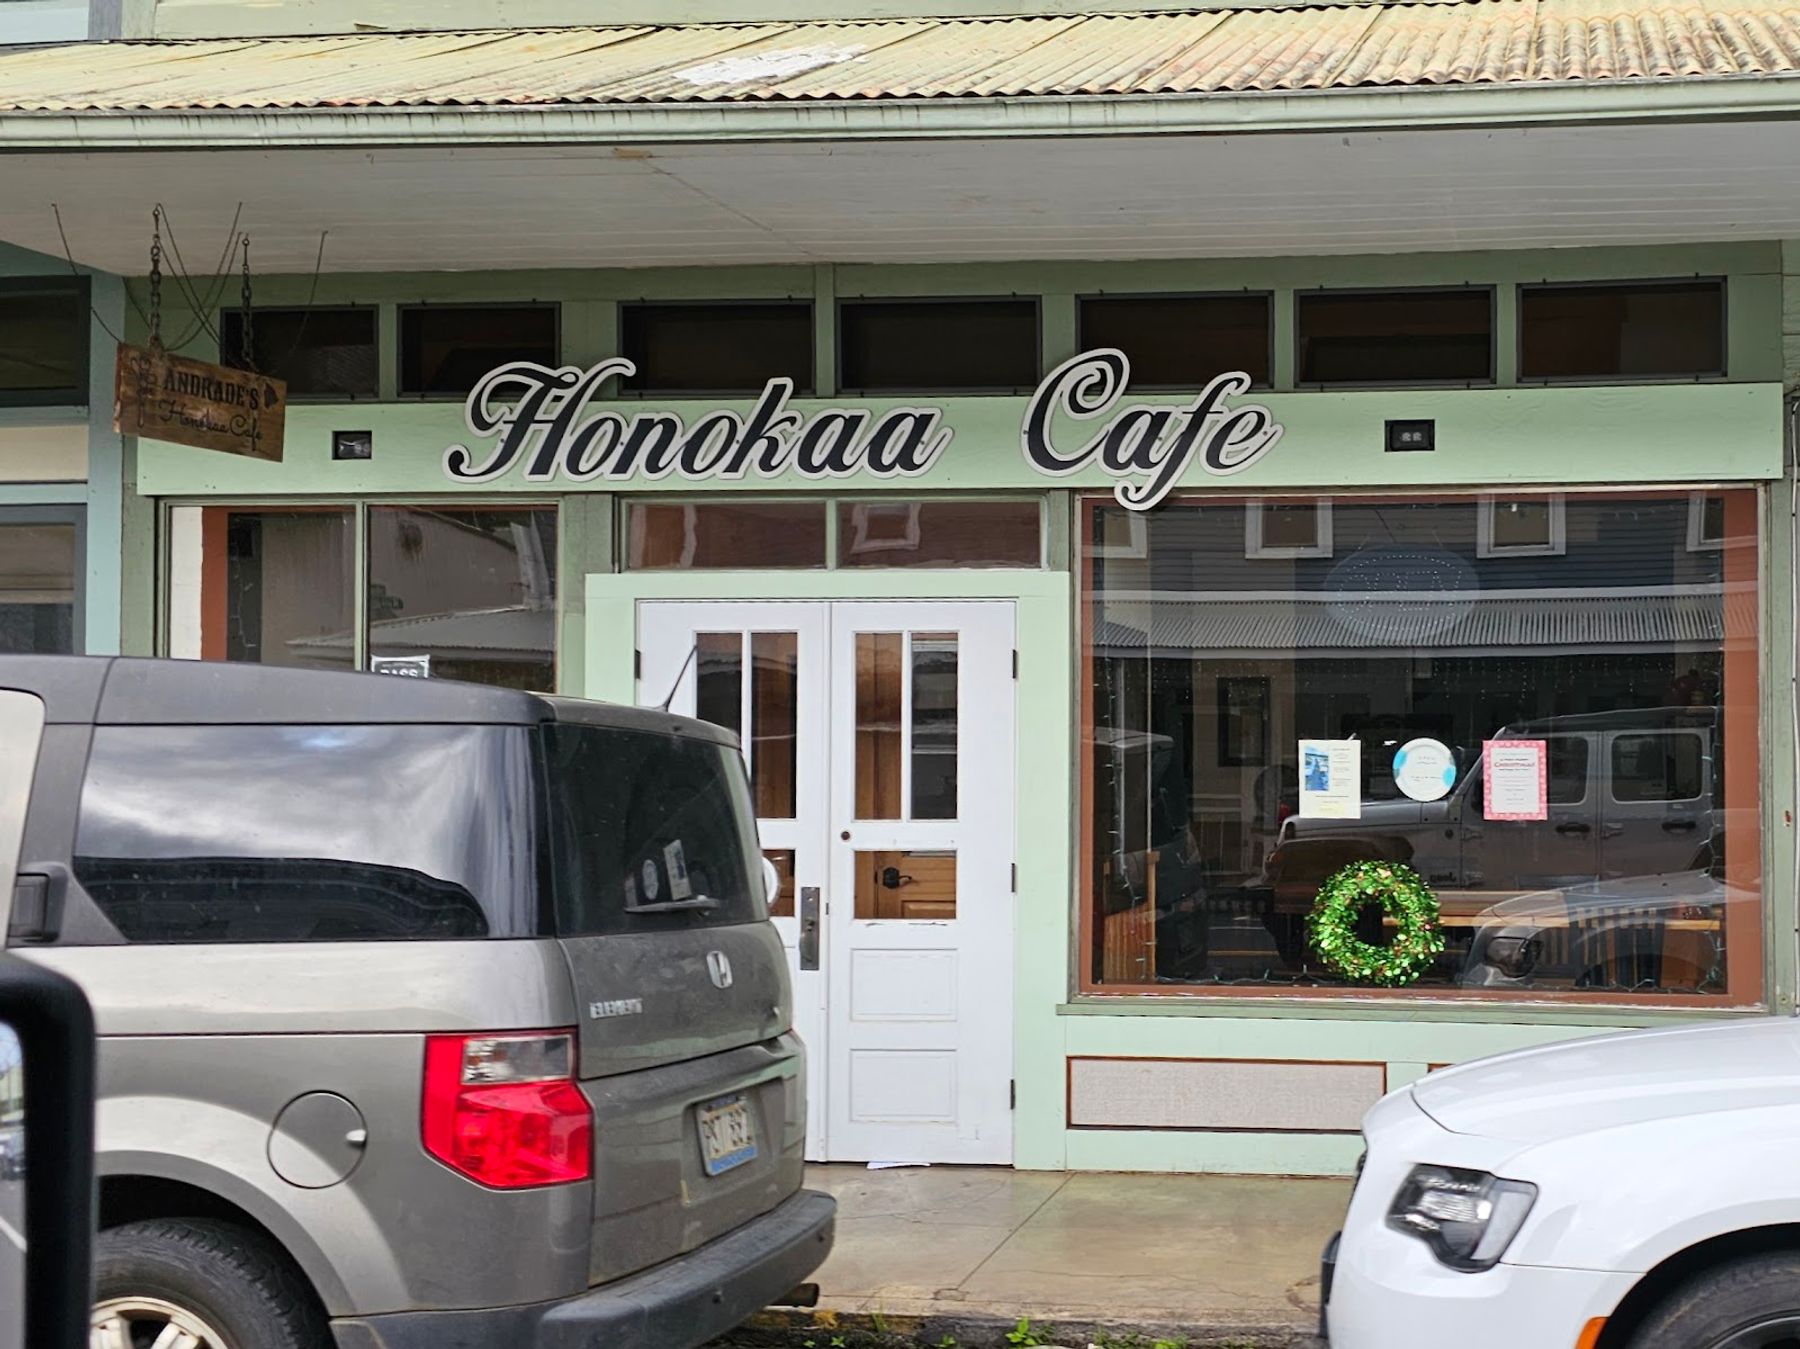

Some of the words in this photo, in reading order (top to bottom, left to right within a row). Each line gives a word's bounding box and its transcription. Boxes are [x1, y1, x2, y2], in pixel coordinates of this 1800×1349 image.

[163, 369, 261, 411] ANDRADE'S
[444, 358, 952, 480] Honokaa
[1021, 348, 1284, 511] Cafe
